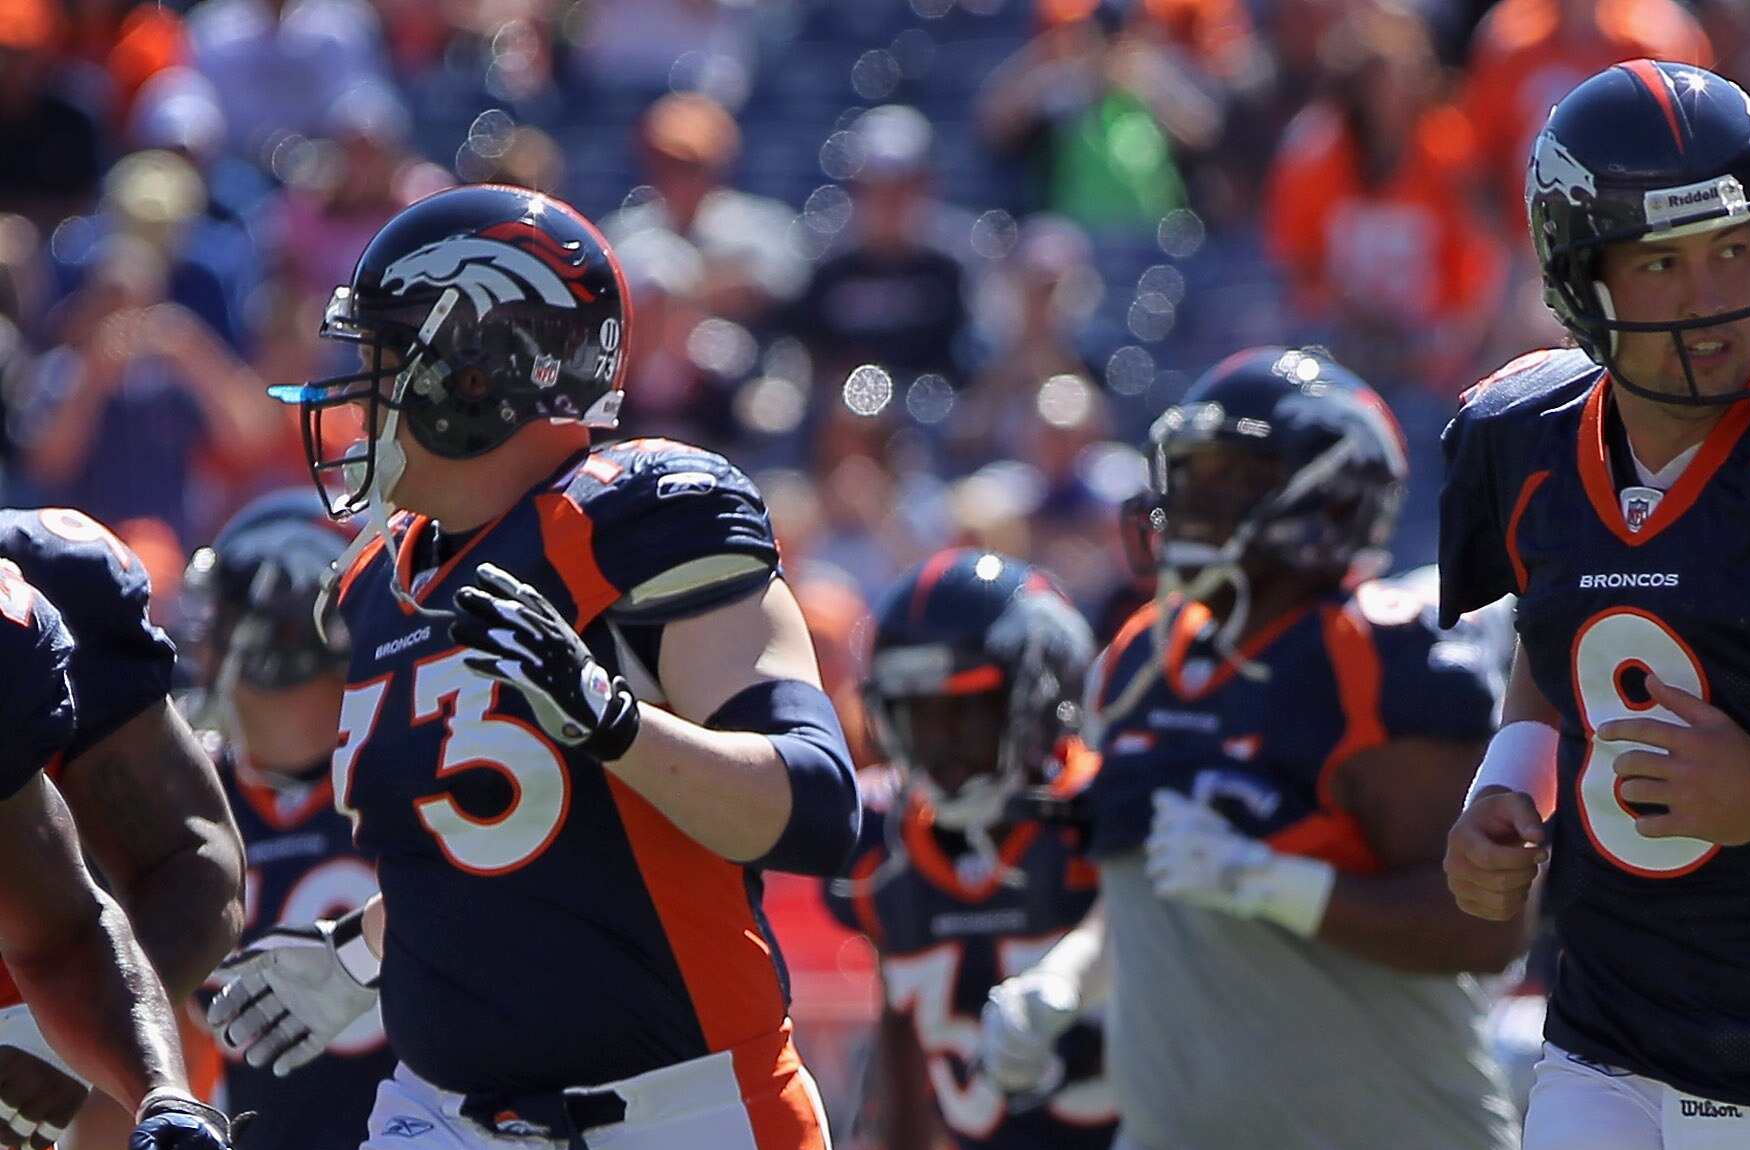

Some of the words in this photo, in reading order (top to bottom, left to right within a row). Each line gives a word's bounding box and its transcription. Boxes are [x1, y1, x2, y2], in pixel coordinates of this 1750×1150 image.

[1668, 186, 1719, 208] Riddell
[595, 354, 617, 382] 73
[1579, 573, 1679, 588] BRONCOS
[375, 626, 431, 660] BRONCOS
[1570, 605, 1722, 879] 8
[331, 645, 573, 877] 73
[1680, 1099, 1743, 1118] Wilson
